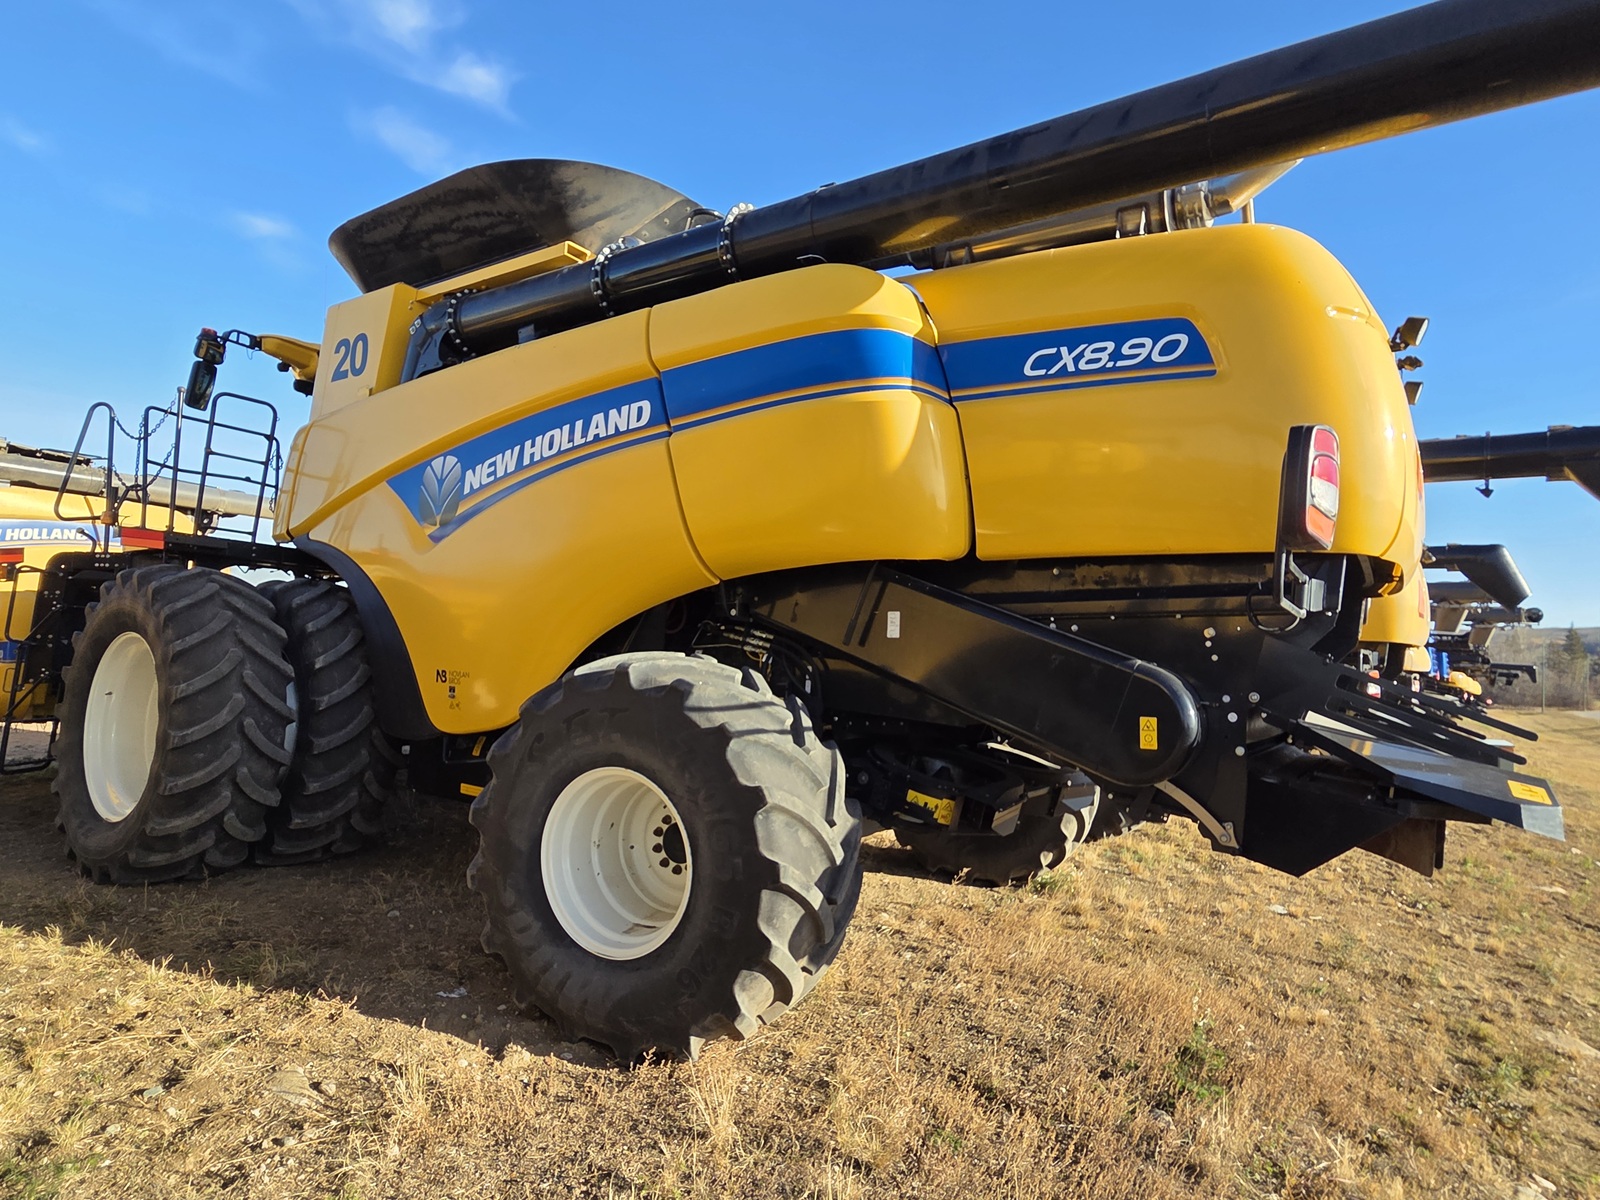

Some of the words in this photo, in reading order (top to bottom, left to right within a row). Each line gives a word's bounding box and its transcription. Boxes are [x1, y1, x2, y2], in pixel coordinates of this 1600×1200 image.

[331, 332, 368, 382] 20
[1023, 333, 1189, 378] CX8.90
[464, 444, 521, 495] NEW
[523, 399, 652, 467] HOLLAND
